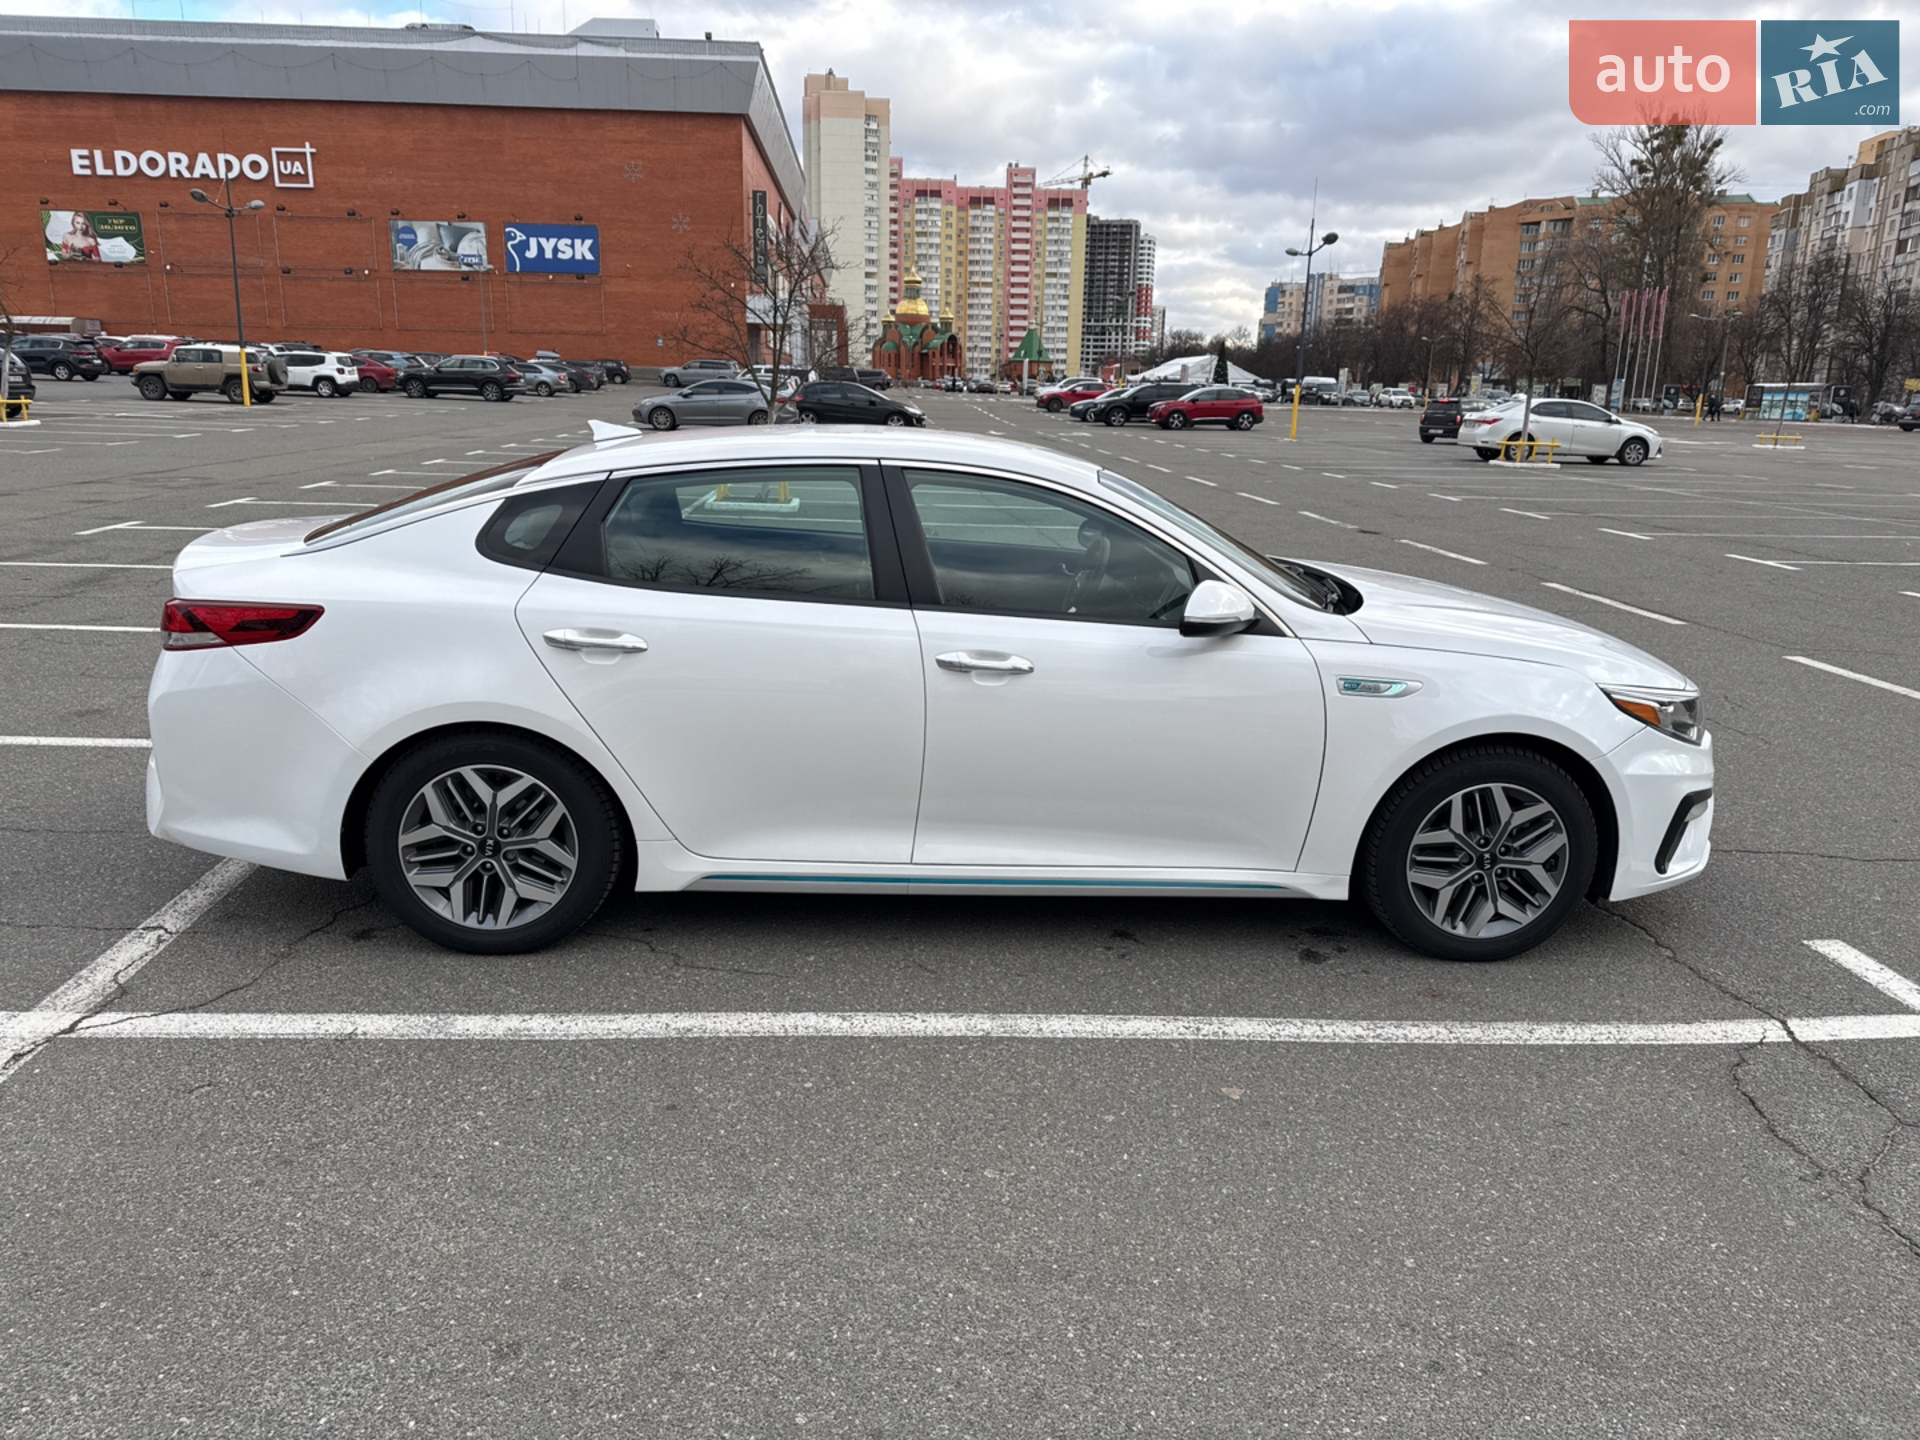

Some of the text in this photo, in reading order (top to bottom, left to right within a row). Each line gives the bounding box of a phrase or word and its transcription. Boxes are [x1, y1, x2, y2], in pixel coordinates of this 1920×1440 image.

[70, 148, 305, 181] ELDORADO UA
[524, 237, 596, 261] JYSK
[484, 839, 494, 856] KIA
[1483, 853, 1491, 870] KIA
